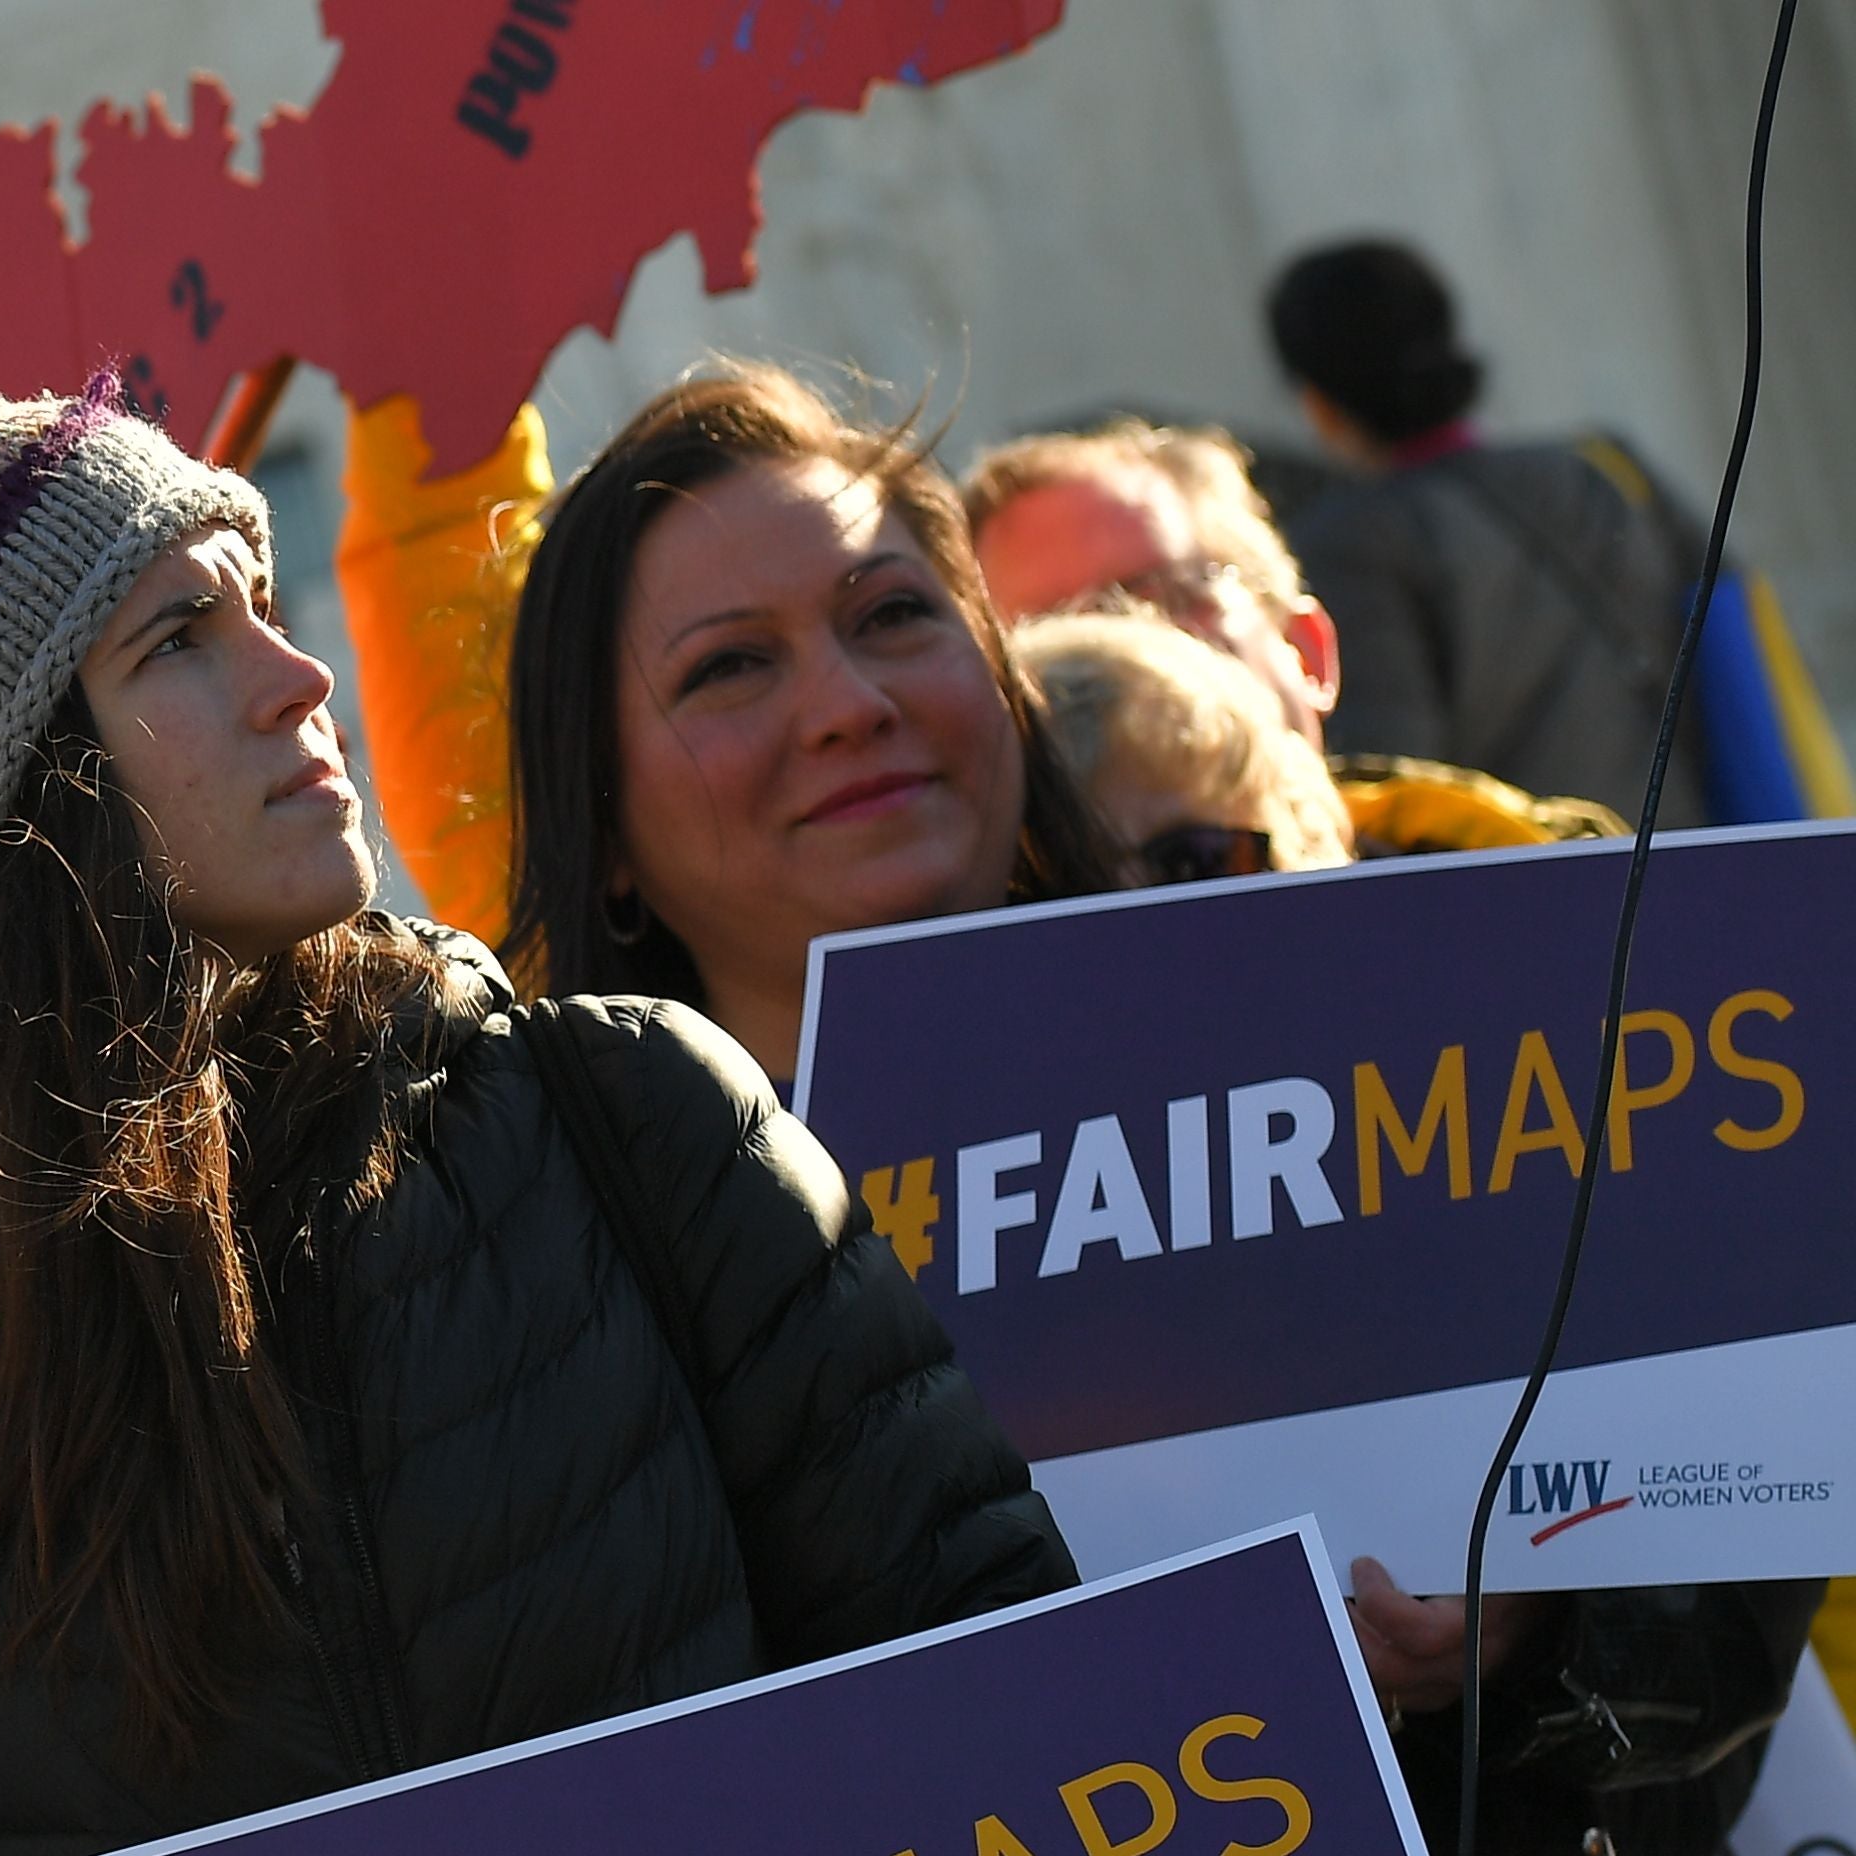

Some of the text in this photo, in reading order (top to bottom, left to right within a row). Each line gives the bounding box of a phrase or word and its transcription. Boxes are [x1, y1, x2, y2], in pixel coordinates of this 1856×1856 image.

[170, 258, 224, 341] 2
[859, 989, 1806, 1296] #FAIRMAPS
[1507, 1460, 1612, 1516] LWV
[1638, 1463, 1765, 1485] LEAGUE OF
[1638, 1481, 1832, 1508] WOMEN VOTERS
